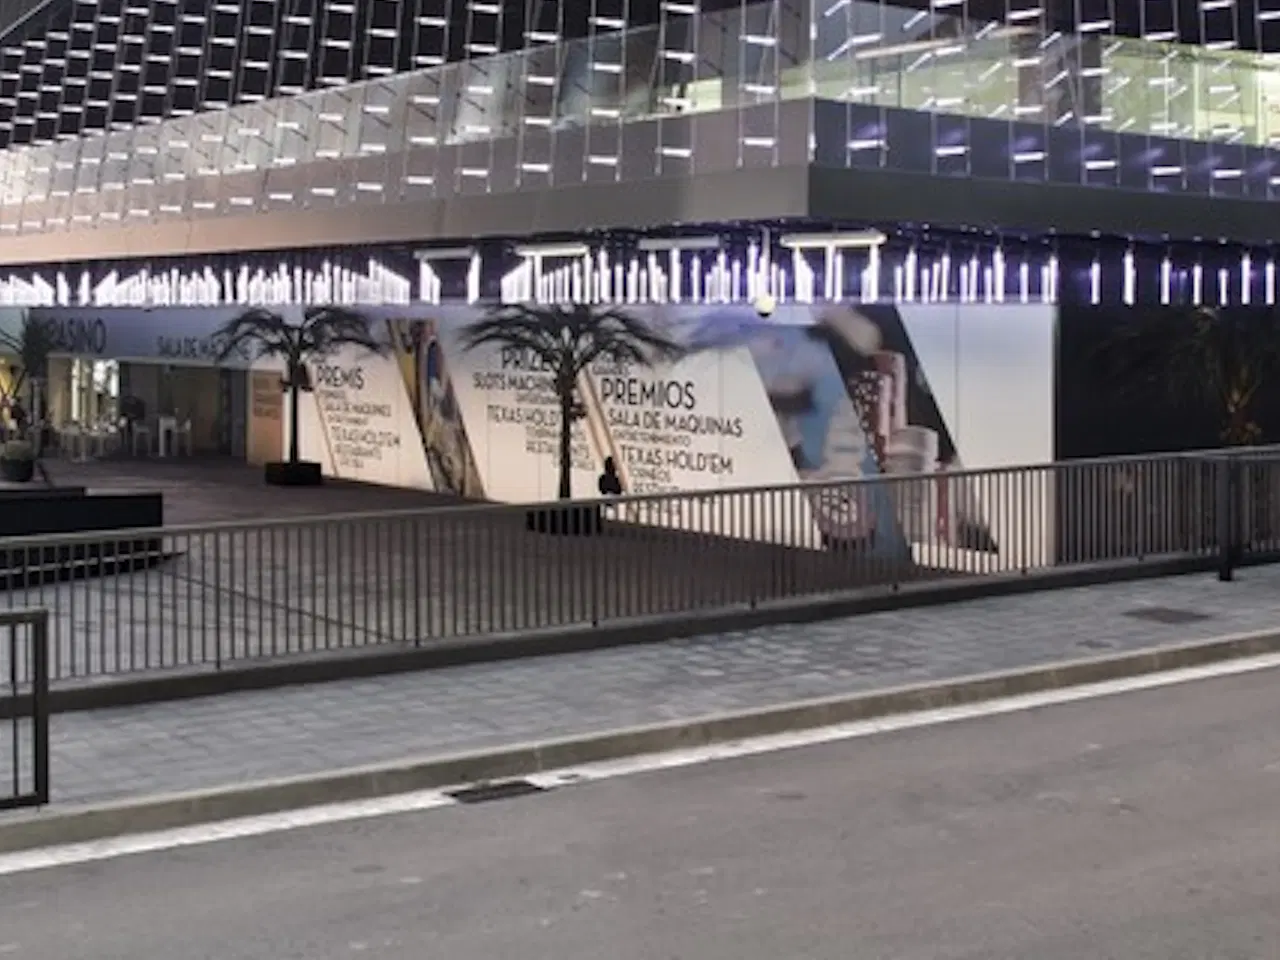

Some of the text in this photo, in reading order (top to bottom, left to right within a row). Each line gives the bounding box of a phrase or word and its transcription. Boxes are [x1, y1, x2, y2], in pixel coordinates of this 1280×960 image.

[601, 378, 697, 409] PREMIOS
[609, 409, 743, 439] SALA DE MAQUINAS
[620, 443, 662, 467] TEXAS
[666, 450, 733, 476] HOLD'EM
